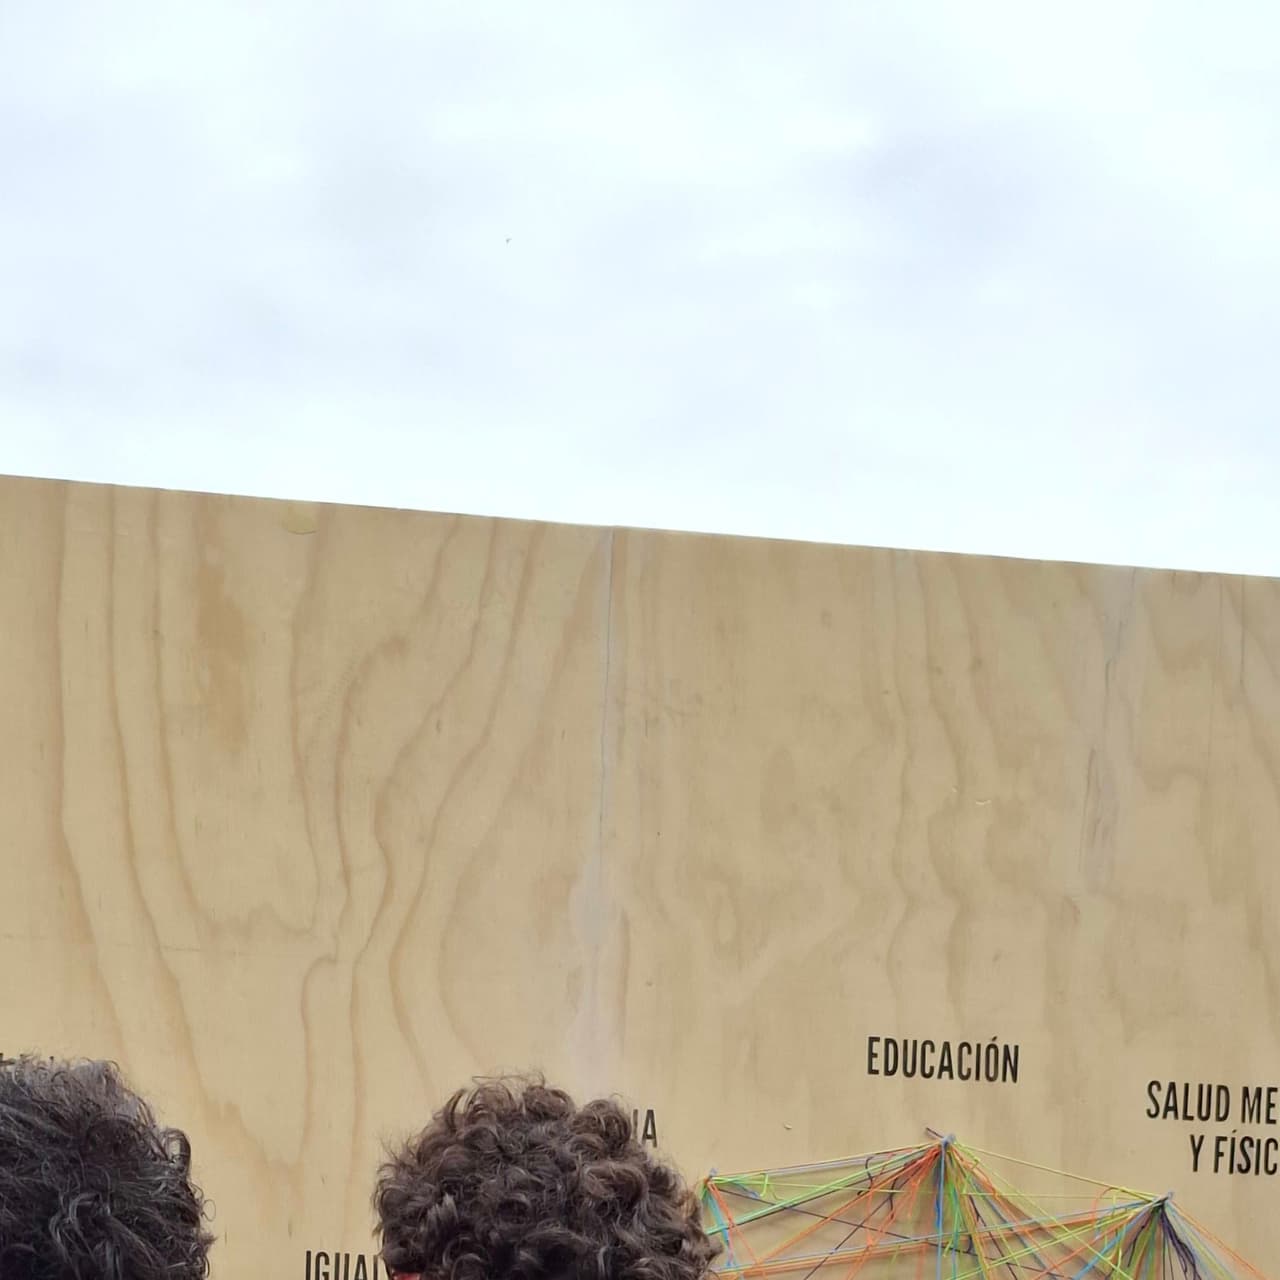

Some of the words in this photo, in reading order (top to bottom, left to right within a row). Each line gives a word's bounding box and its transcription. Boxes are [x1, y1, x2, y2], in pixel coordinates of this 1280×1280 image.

[866, 1035, 1020, 1084] EDUCACIÓN
[1146, 1080, 1231, 1123] SALUD
[1188, 1133, 1202, 1173] Y
